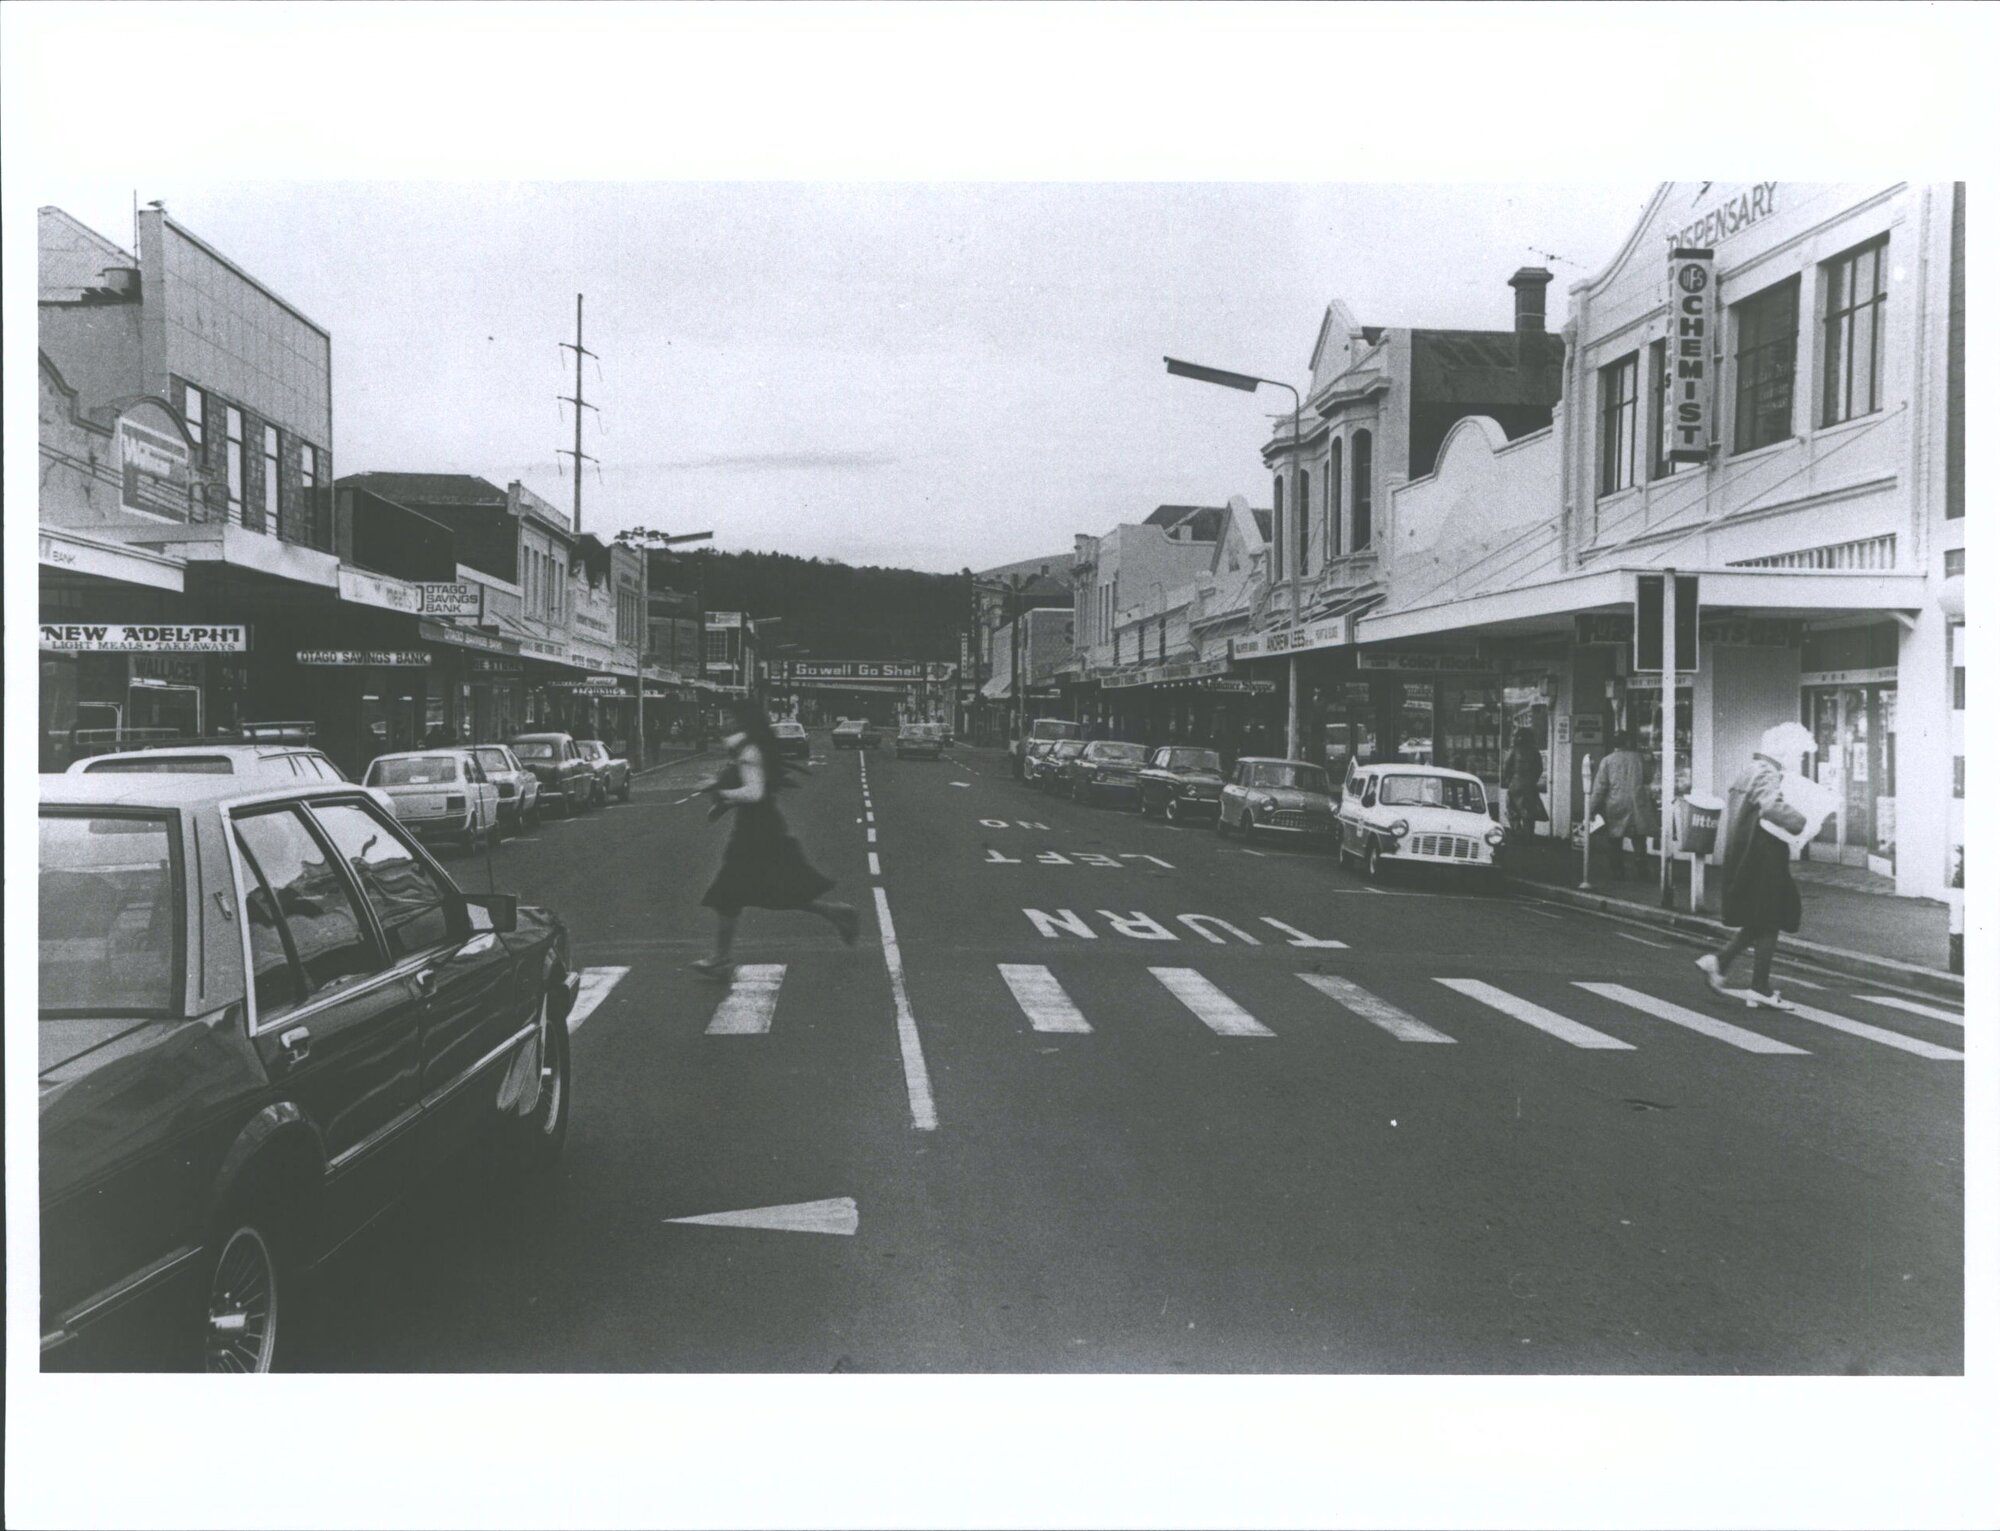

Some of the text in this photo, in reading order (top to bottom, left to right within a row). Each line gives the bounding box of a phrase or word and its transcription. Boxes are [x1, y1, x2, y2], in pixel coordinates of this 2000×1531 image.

[1667, 181, 1778, 249] DISPENSARY
[1682, 266, 1705, 291] UFS
[1677, 295, 1704, 445] CHEMIST
[426, 584, 467, 594] OTAGO
[426, 594, 478, 604] SAVINGS
[426, 604, 461, 612] BANK
[41, 626, 239, 643] NEW ADELPHI
[1291, 628, 1305, 648] LEES
[52, 641, 236, 651] LIGHT MEALS TAKEAWAYS
[301, 652, 427, 664] OTAGO SAVINGS BANK
[858, 664, 878, 676] Go
[883, 665, 920, 676] Shell
[978, 818, 1051, 830] NO
[1692, 813, 1718, 829] litte
[984, 849, 1177, 868] LEFT
[1021, 908, 1351, 949] TURN
